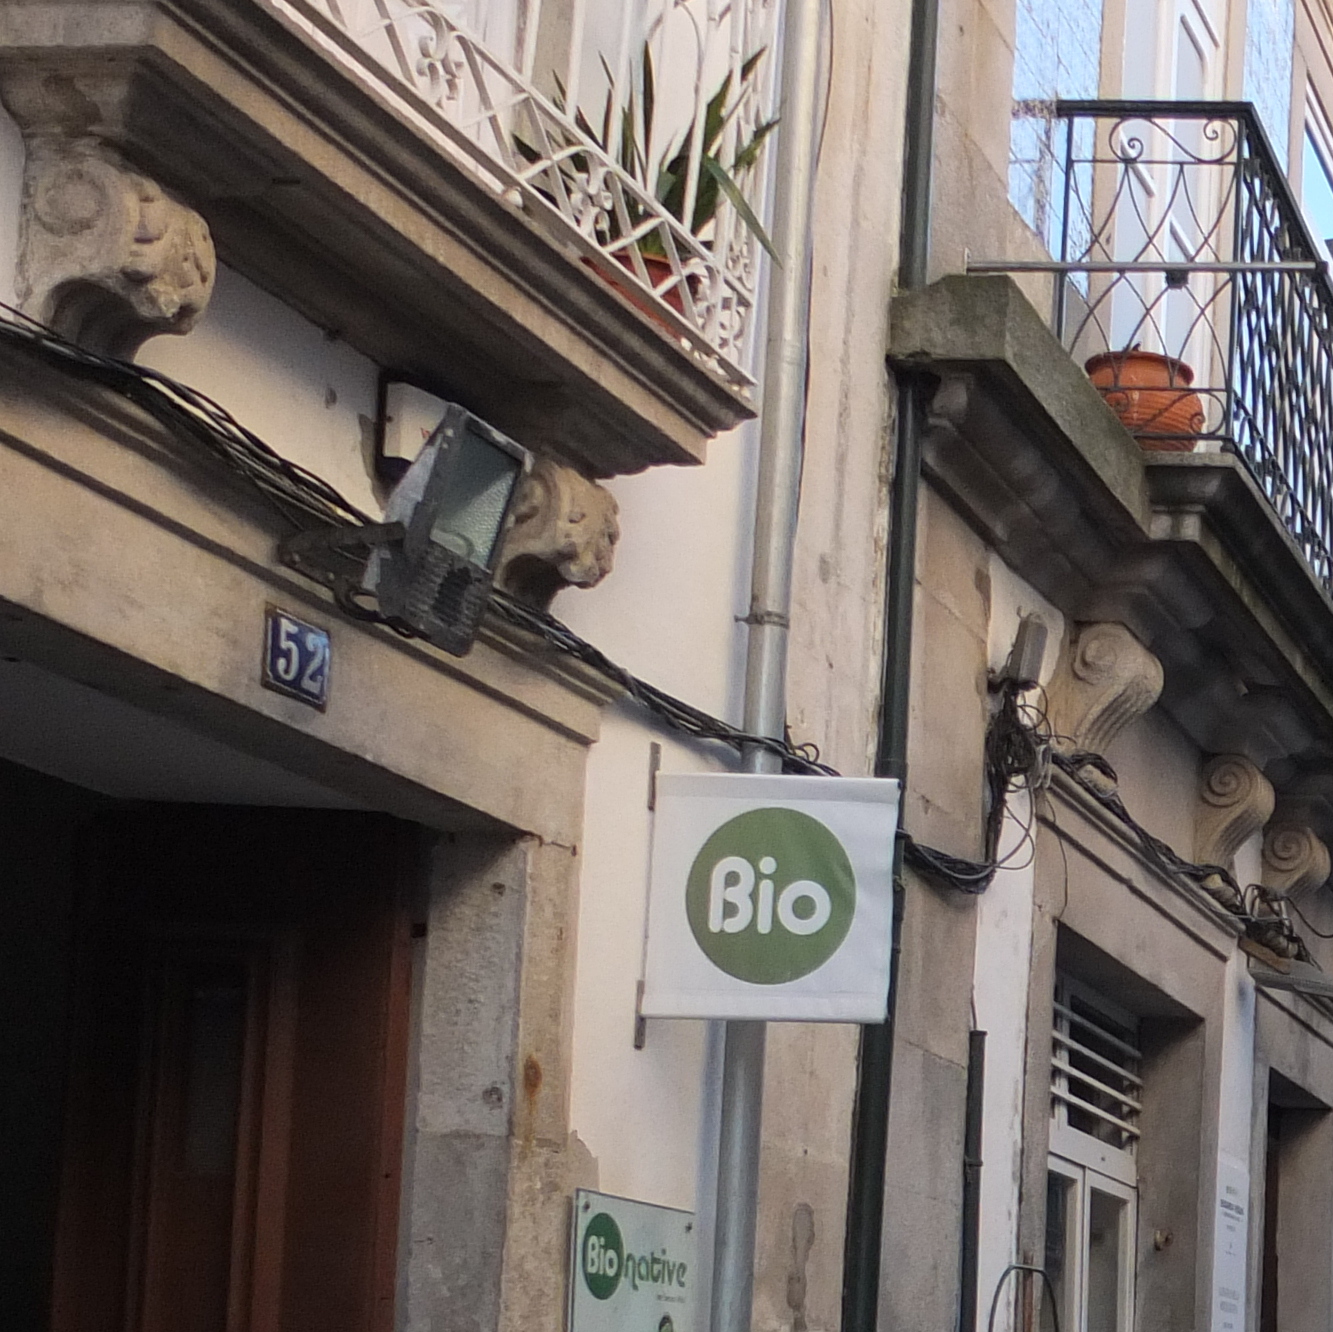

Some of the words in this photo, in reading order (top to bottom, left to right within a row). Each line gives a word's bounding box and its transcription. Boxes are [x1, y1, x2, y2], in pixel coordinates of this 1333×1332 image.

[277, 617, 329, 695] 52
[709, 856, 832, 936] Bio
[586, 1235, 619, 1277] Bio
